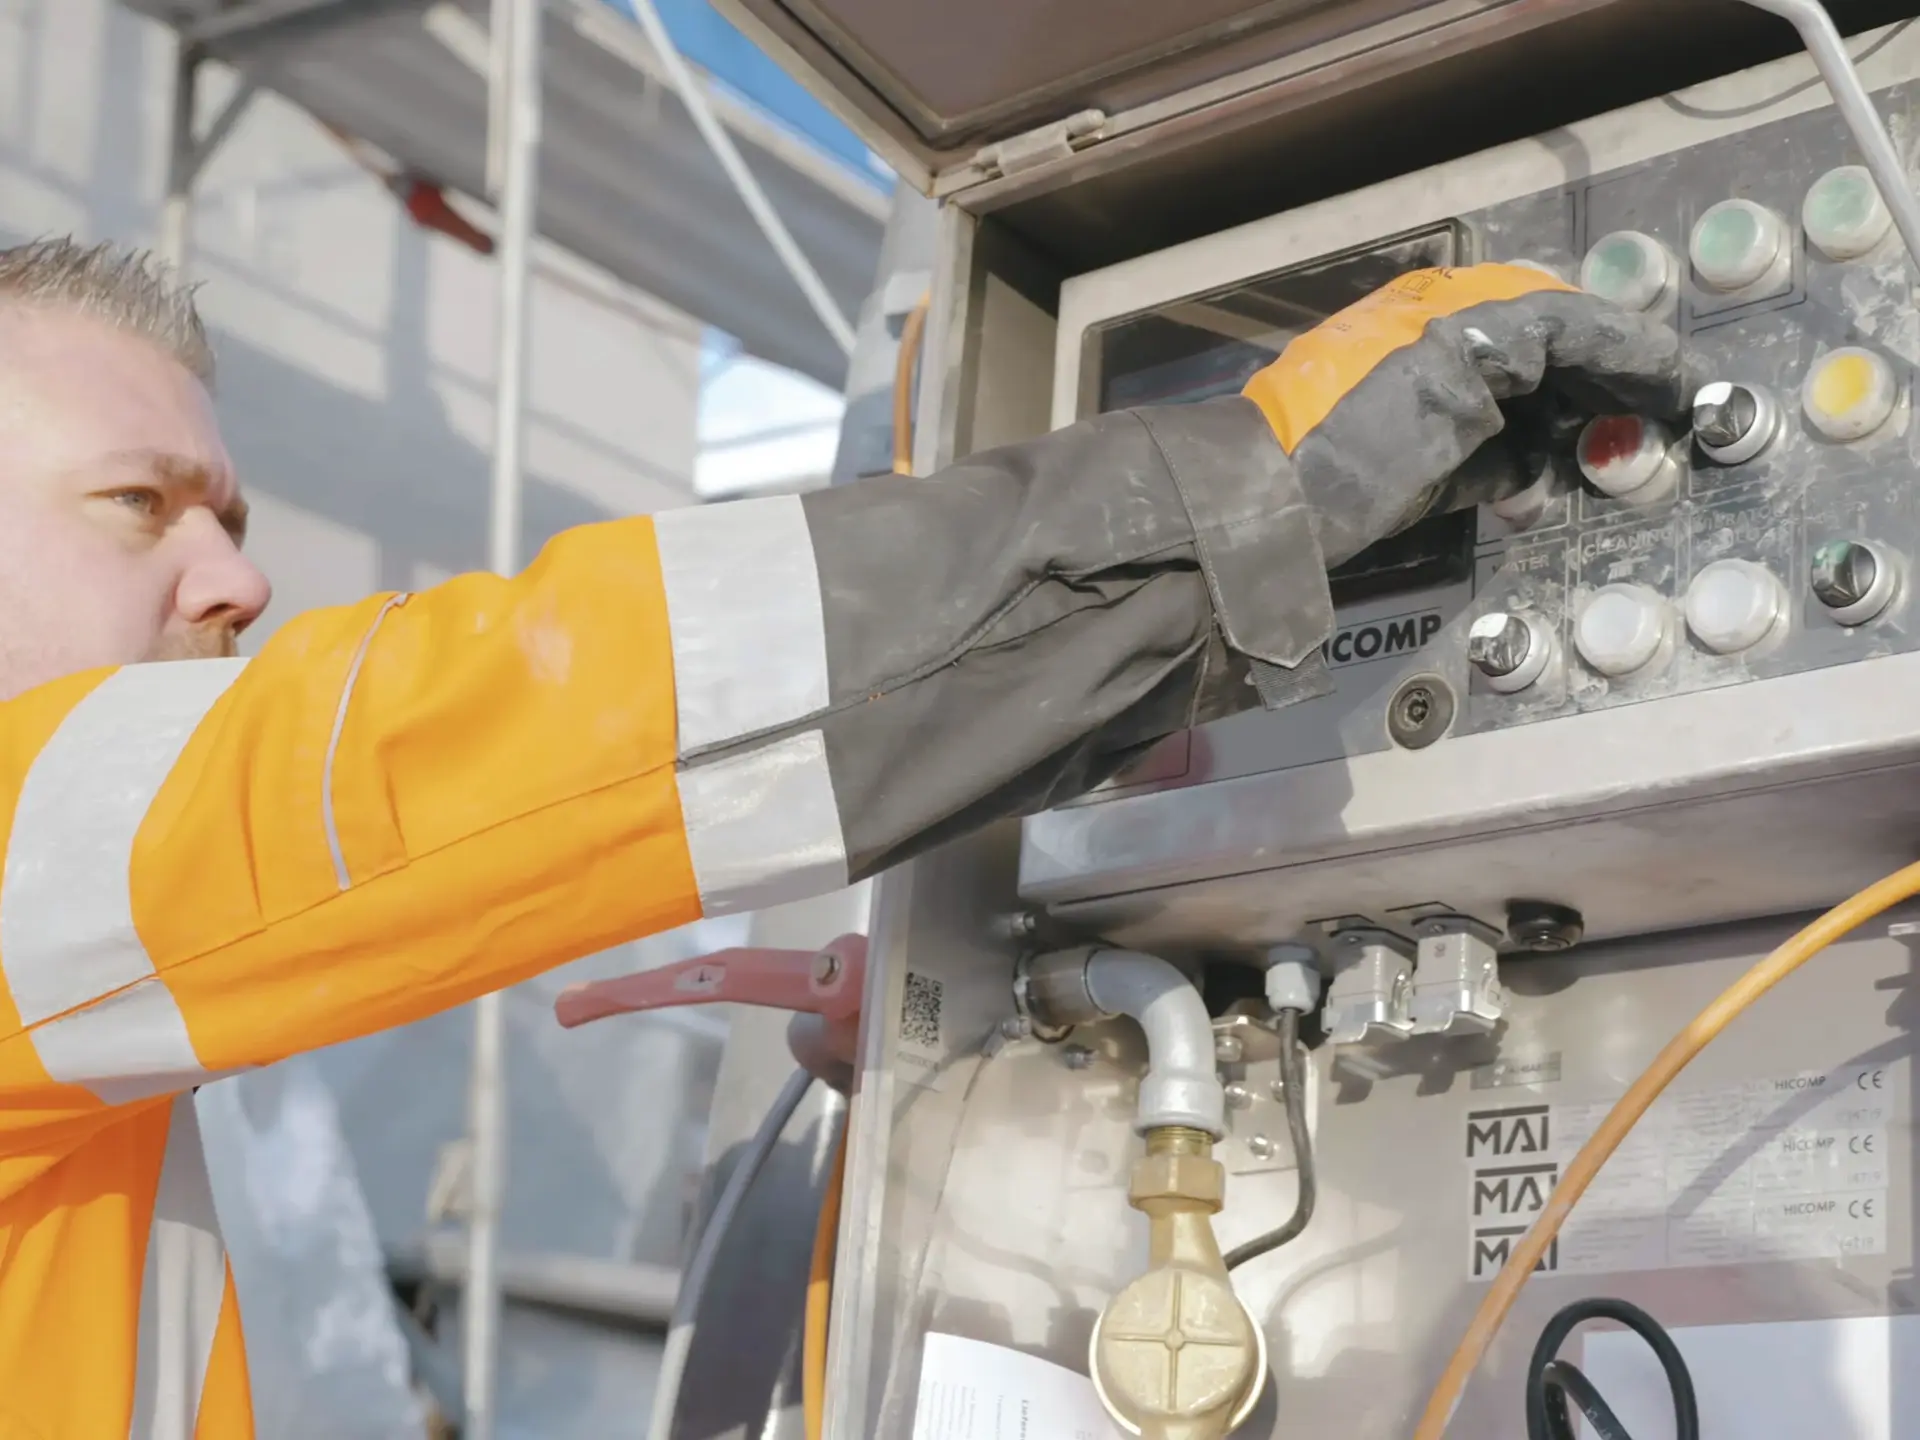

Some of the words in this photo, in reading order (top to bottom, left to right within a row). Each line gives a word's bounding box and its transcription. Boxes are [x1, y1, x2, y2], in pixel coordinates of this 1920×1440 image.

[1321, 614, 1442, 664] ICOMP
[1774, 1075, 1827, 1091] HICOMP
[1466, 1115, 1549, 1158] MAI
[1783, 1200, 1837, 1216] HICOMP
[1473, 1233, 1557, 1276] MI
